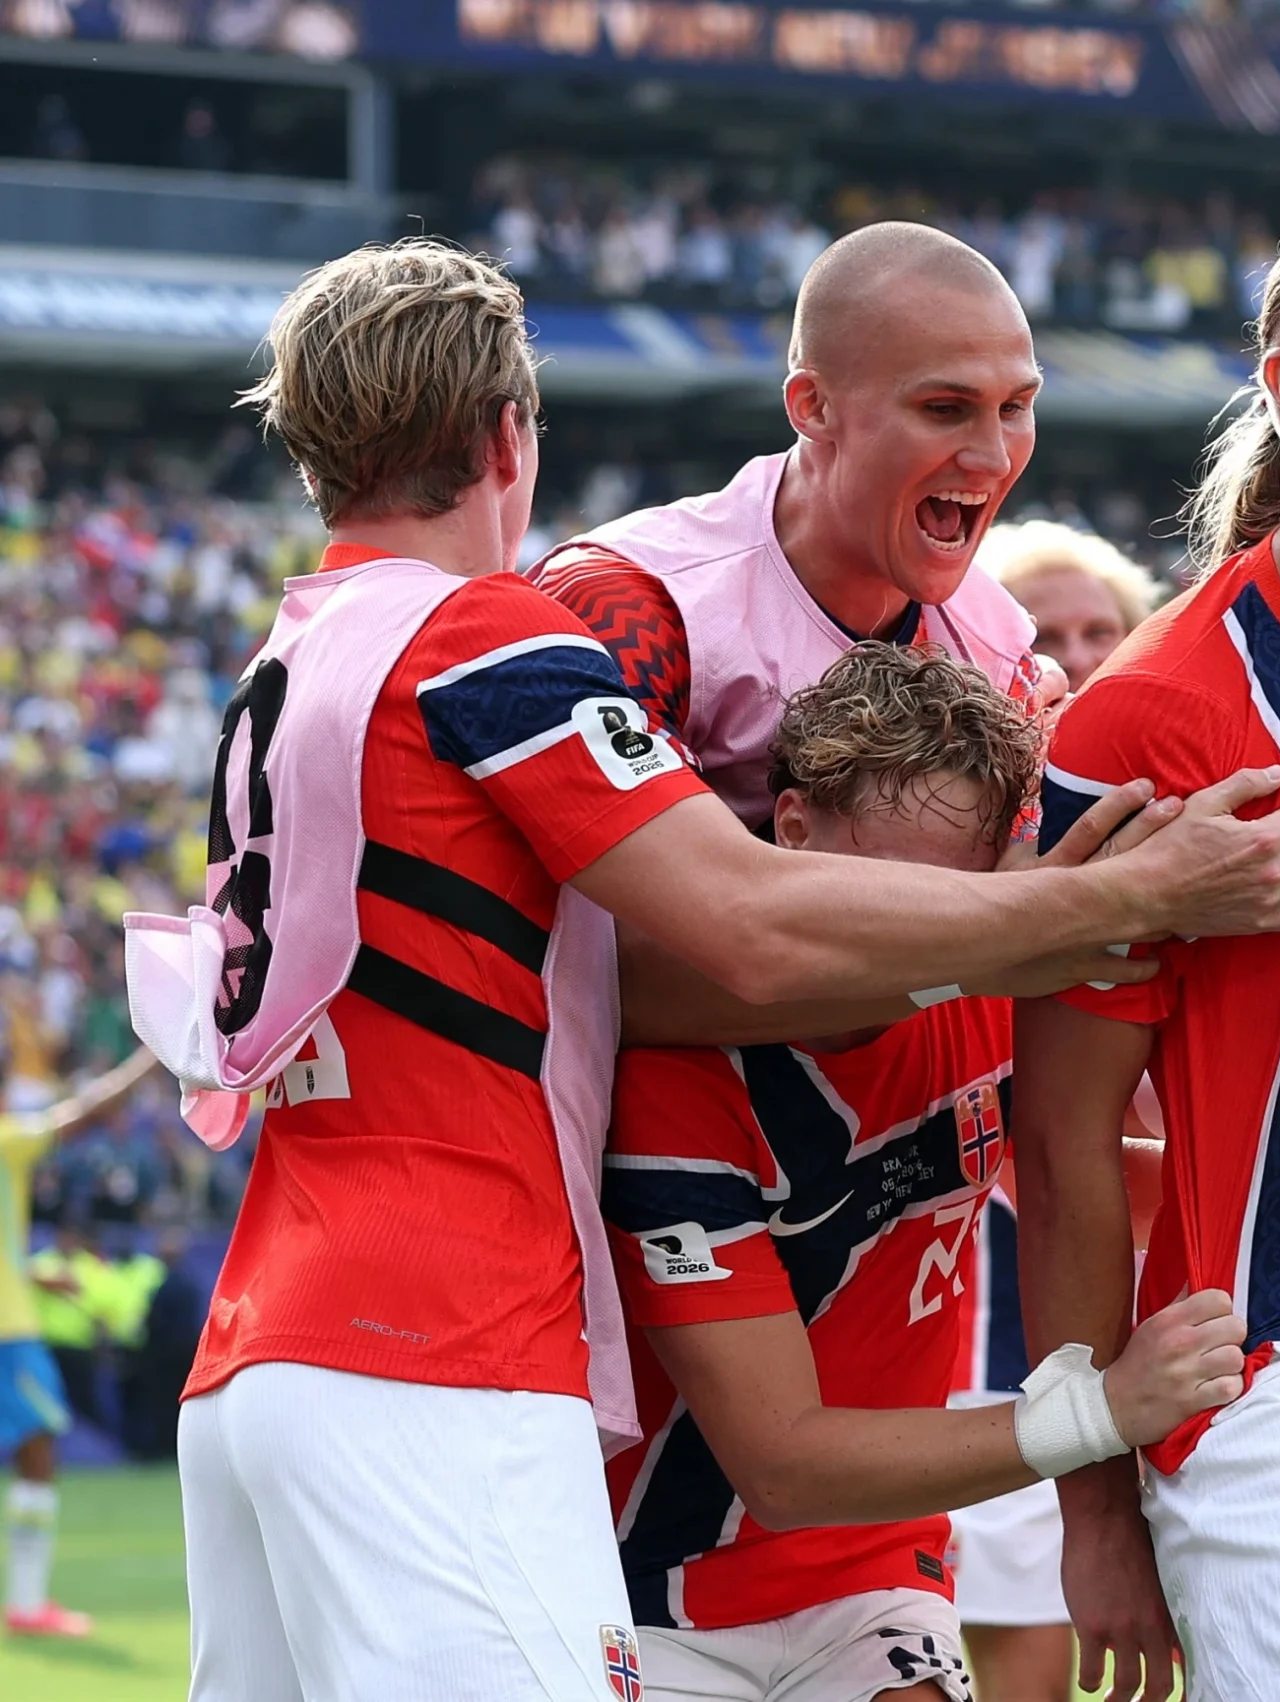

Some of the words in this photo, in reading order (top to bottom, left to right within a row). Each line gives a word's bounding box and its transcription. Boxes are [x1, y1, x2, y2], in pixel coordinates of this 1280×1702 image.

[626, 743, 645, 755] FIFA
[632, 760, 665, 776] 2026
[882, 1156, 902, 1174] BRA
[667, 1263, 709, 1275] 2026
[349, 1316, 432, 1345] AERO-FIT
